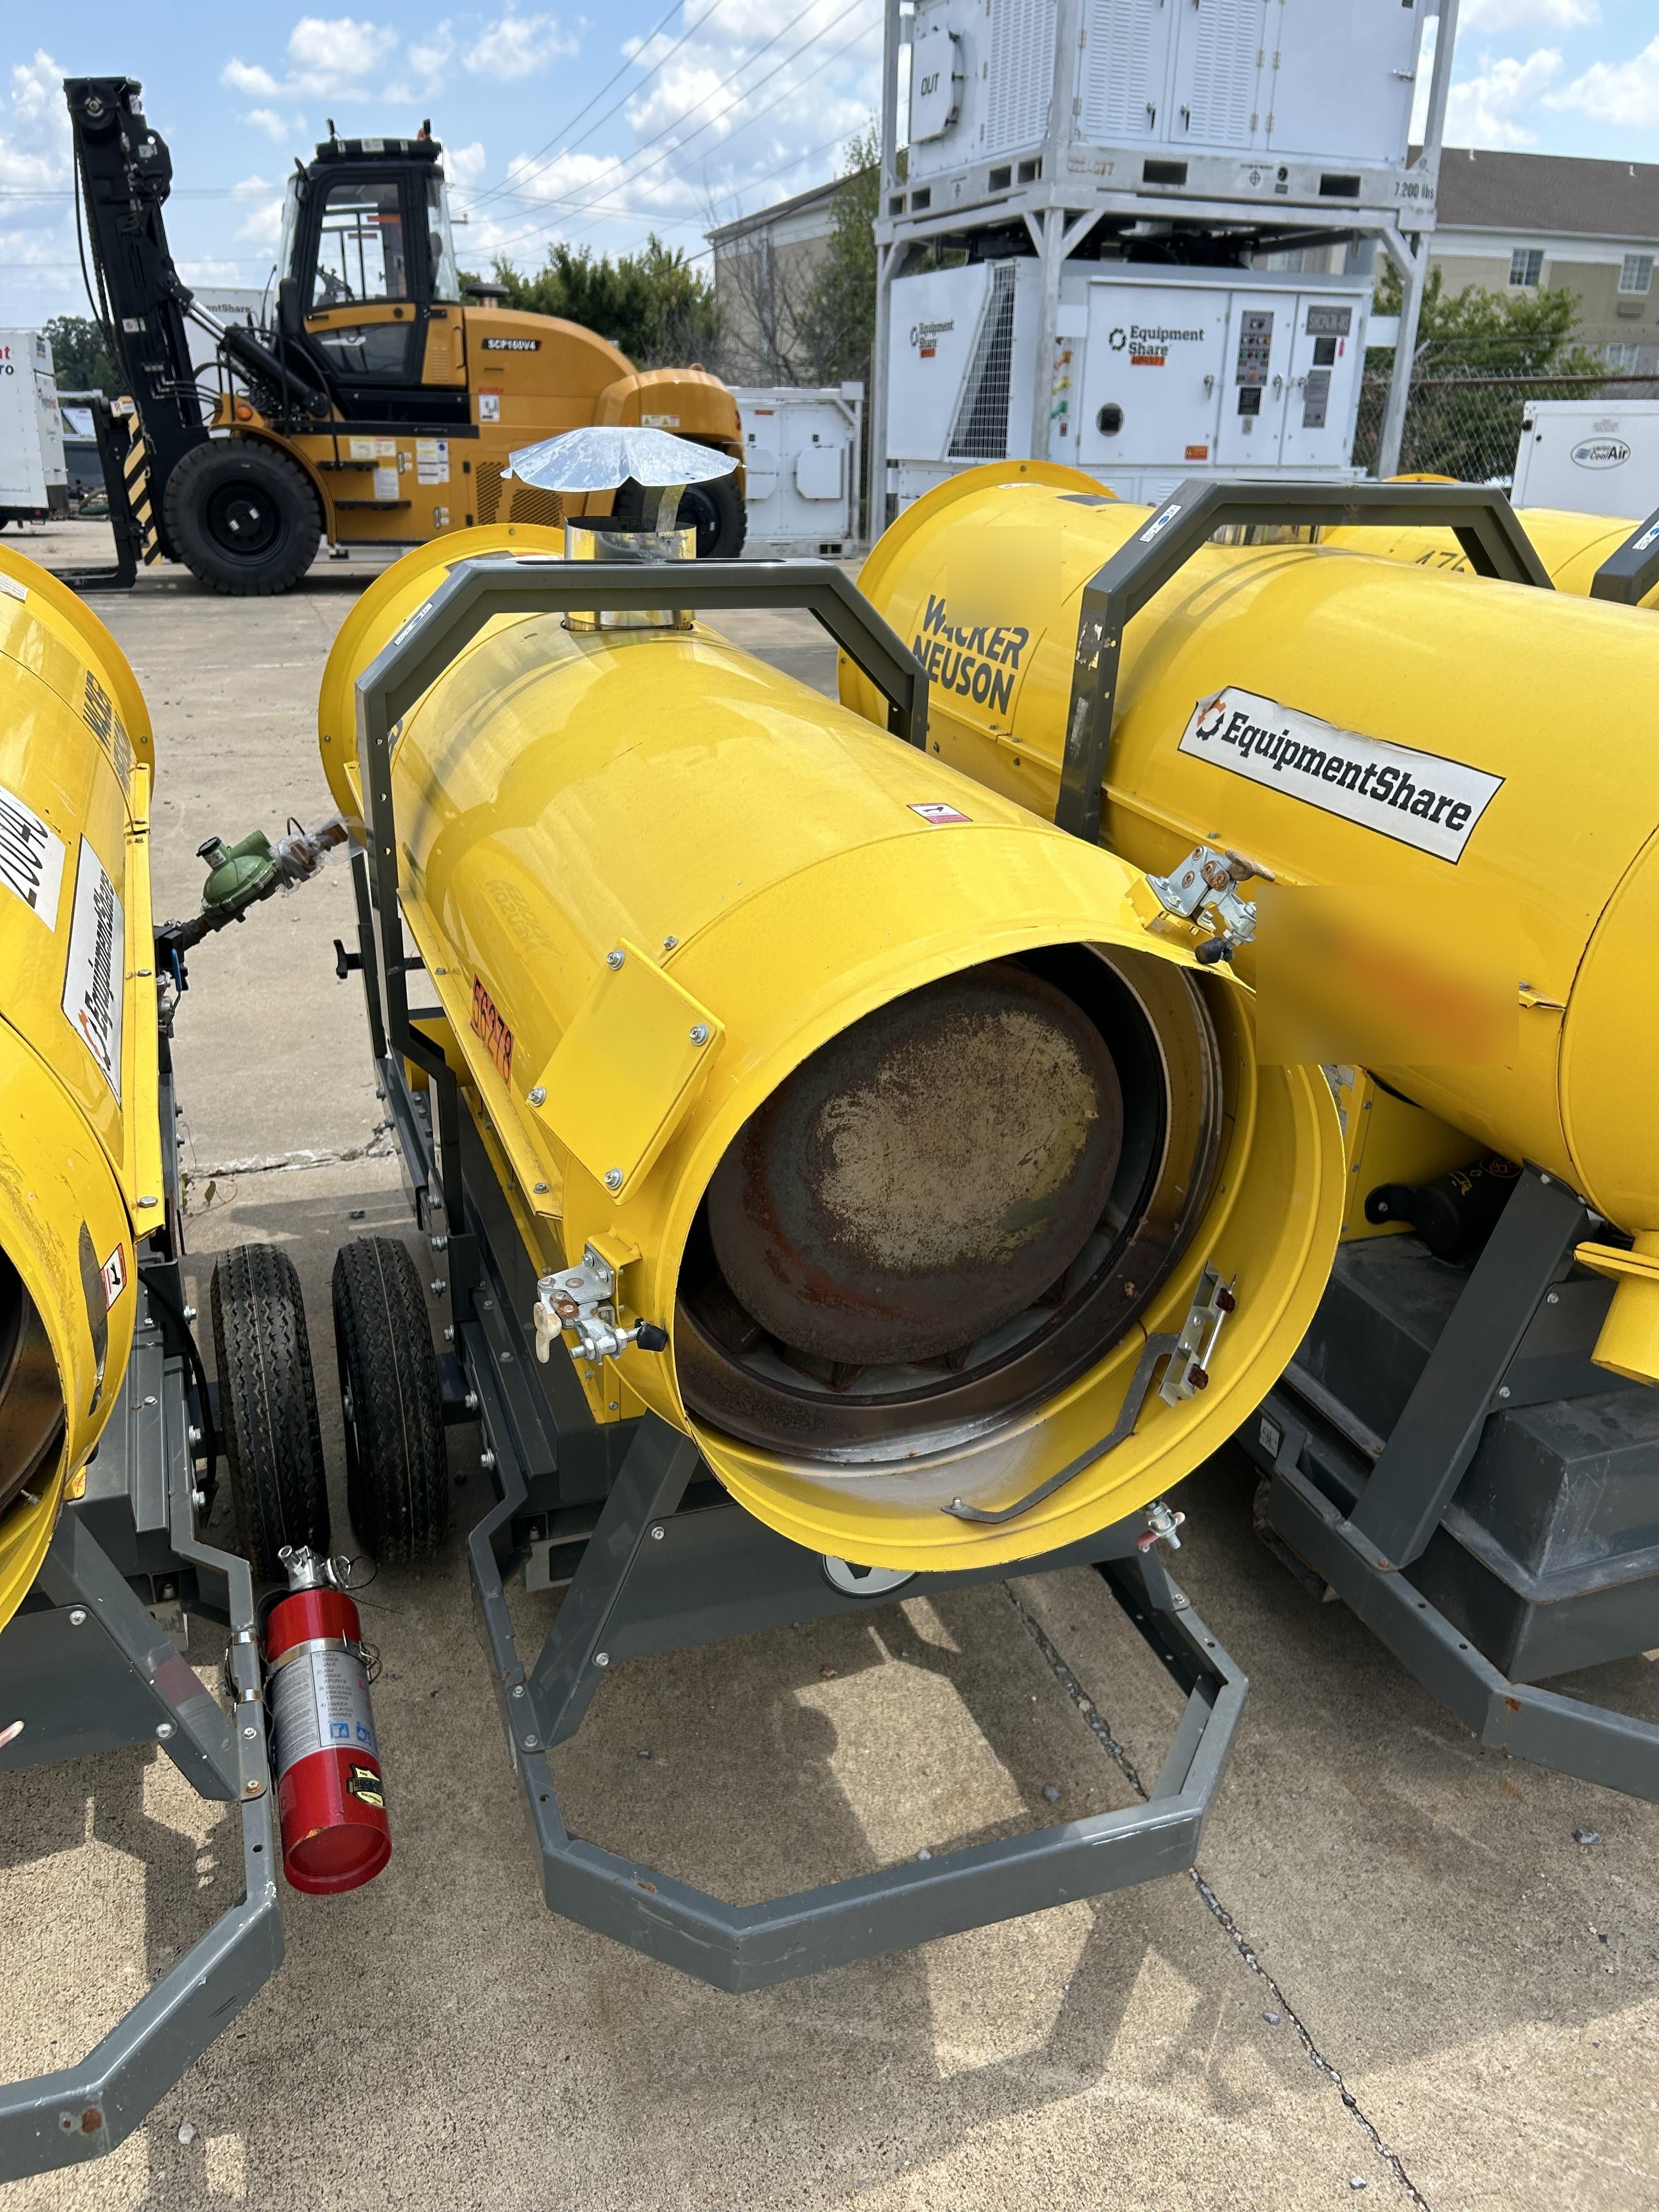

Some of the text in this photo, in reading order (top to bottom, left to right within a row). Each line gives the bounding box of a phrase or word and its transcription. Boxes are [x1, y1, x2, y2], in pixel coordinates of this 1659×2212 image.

[921, 72, 940, 96] OUT
[1128, 341, 1169, 356] Share
[1130, 325, 1204, 342] Equipment
[912, 635, 1015, 715] NEUSON
[1221, 712, 1472, 831] EquipmentShare
[85, 868, 114, 1041] EquipmentShare
[473, 978, 513, 1085] 56278
